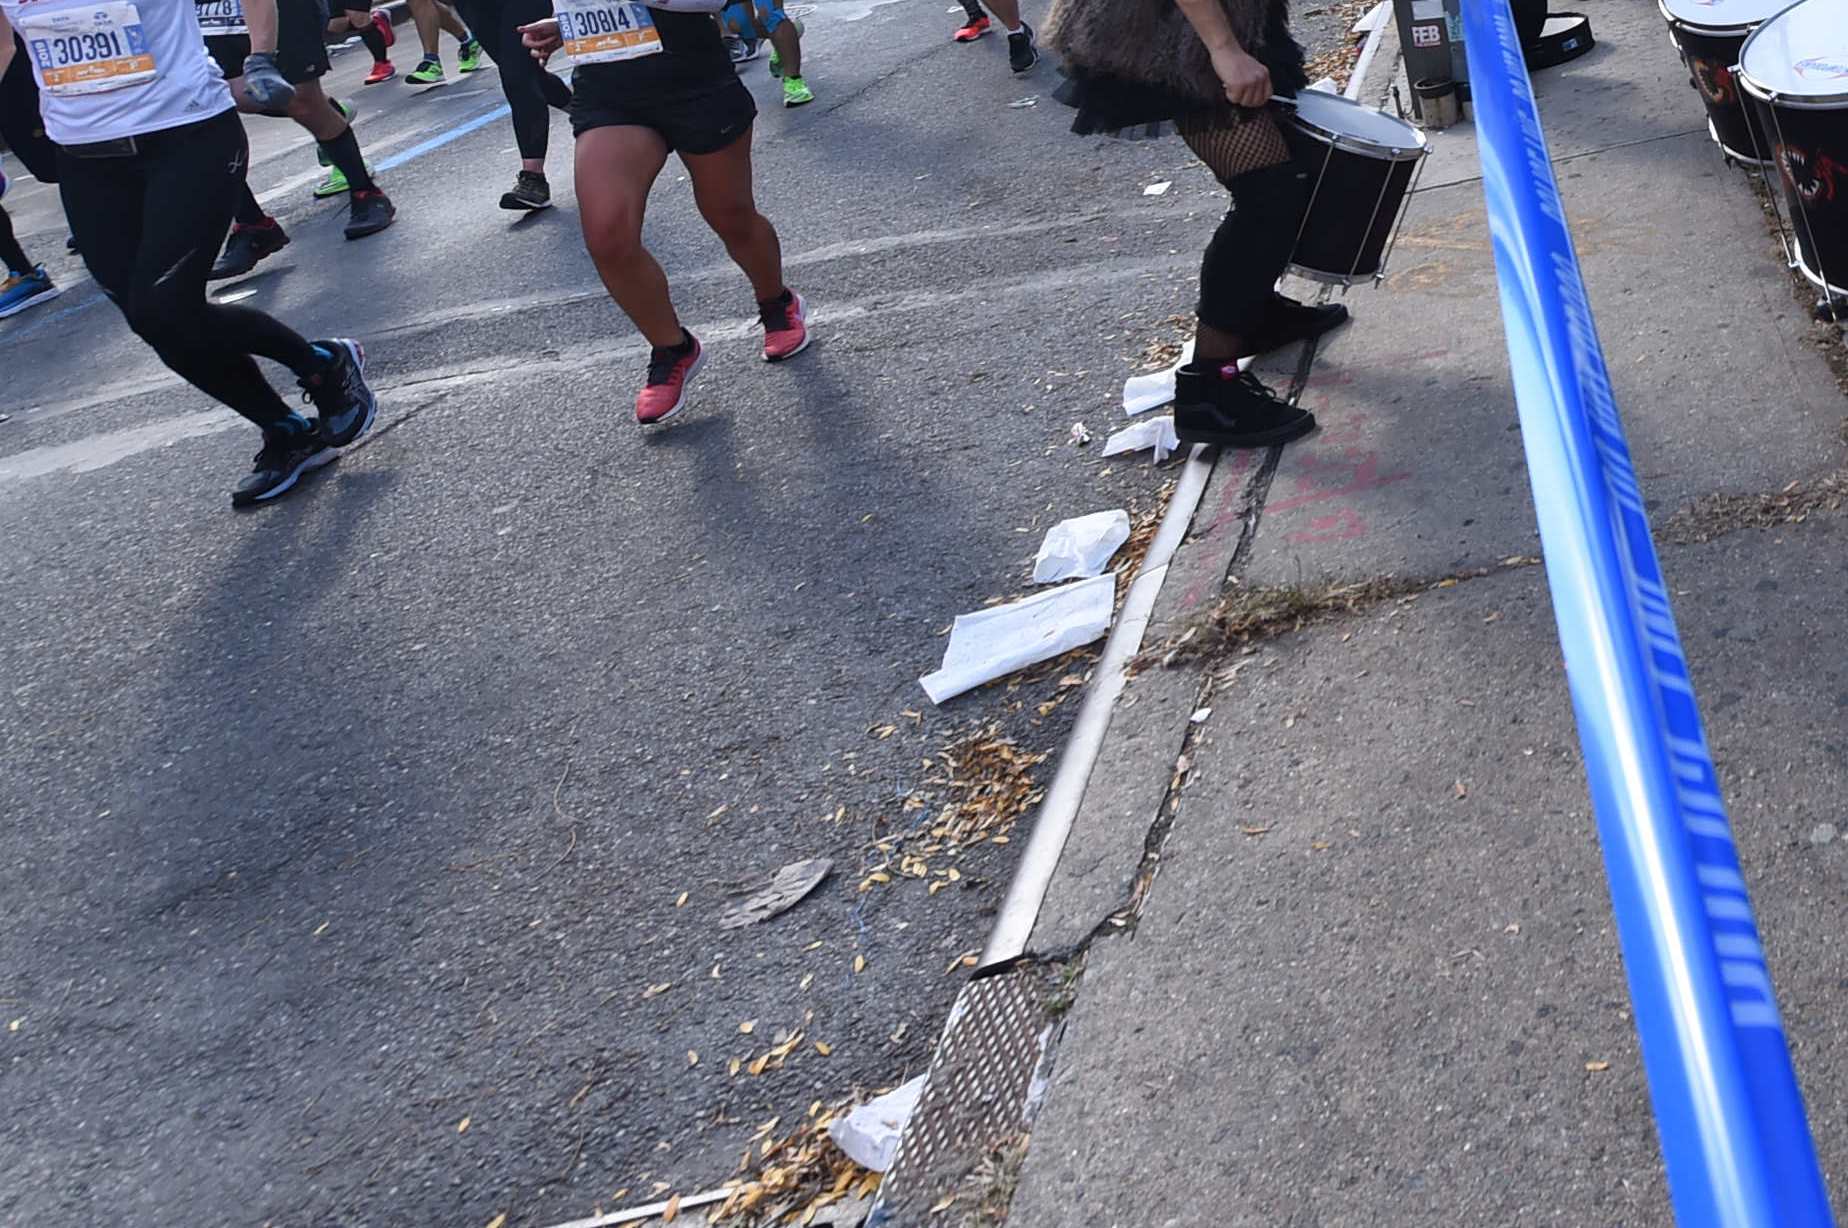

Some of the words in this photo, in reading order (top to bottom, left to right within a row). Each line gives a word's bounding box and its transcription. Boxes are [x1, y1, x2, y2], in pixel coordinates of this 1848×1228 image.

[575, 7, 631, 36] 30814
[1412, 25, 1440, 43] FEB
[53, 30, 122, 64] 30391
